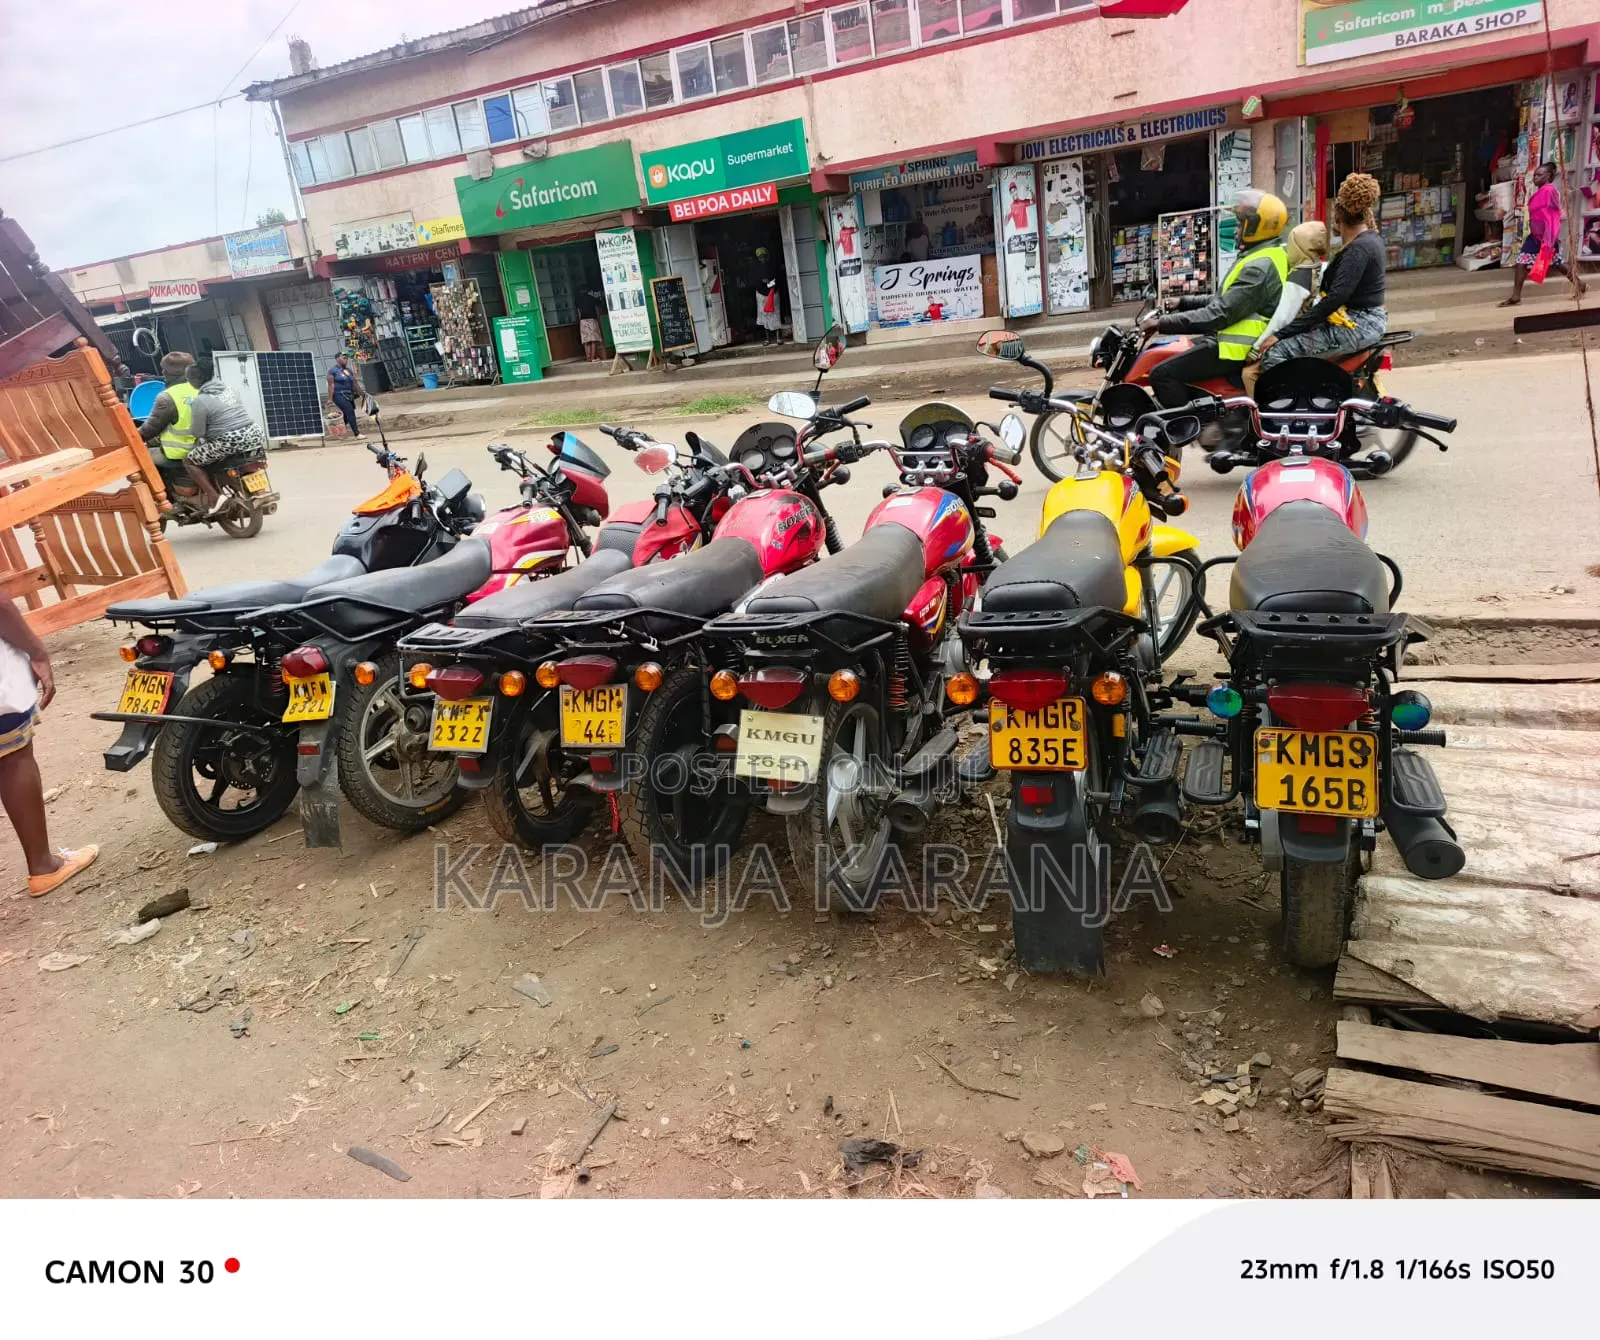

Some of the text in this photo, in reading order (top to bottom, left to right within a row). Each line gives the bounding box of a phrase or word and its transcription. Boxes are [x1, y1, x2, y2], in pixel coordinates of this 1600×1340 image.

[1334, 7, 1416, 33] Safaricom
[1395, 10, 1527, 47] BARAKA SHOP
[1020, 107, 1227, 160] JOVI ELECTRICALS & ELECTRONICS
[727, 142, 794, 166] Supermarket
[853, 175, 898, 192] PURIFIED
[900, 167, 951, 184] DRINKING
[510, 179, 598, 210] Safaricom
[674, 186, 772, 218] BEI POA DAILY
[880, 267, 903, 291] J
[908, 265, 977, 290] Springs
[881, 285, 979, 300] PURIFIED DRINKING WATER
[130, 673, 168, 695] KMGN
[1006, 701, 1080, 728] KMGR
[746, 728, 816, 746] KMGU
[1008, 737, 1080, 766] 835E
[1277, 733, 1372, 769] KMGS
[1279, 774, 1369, 812] 165B
